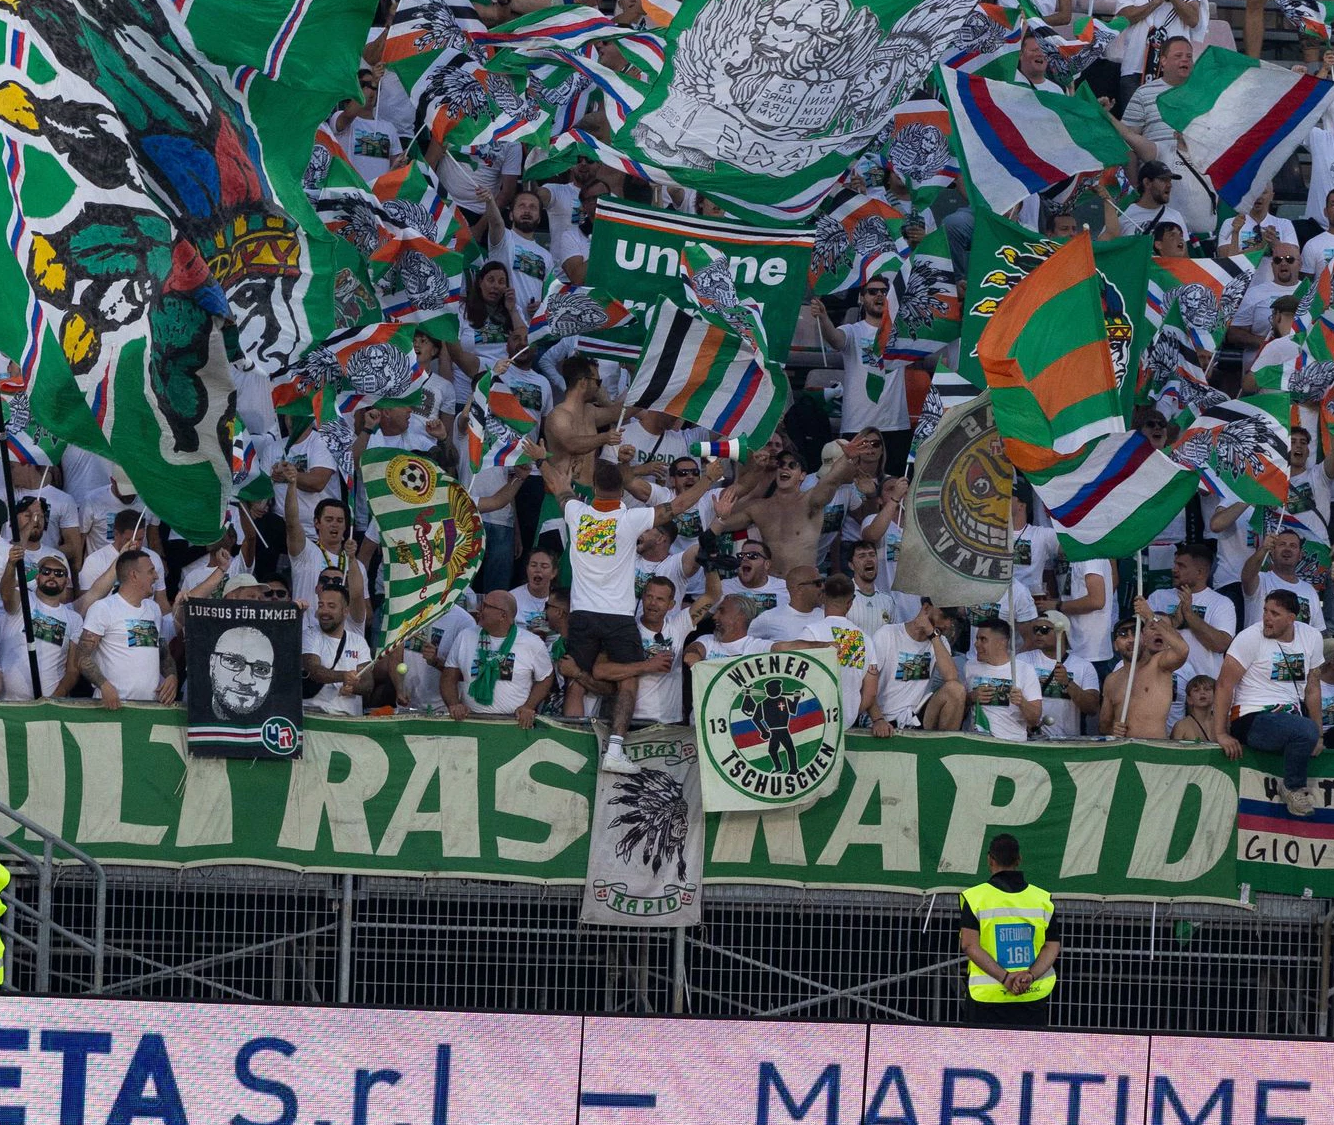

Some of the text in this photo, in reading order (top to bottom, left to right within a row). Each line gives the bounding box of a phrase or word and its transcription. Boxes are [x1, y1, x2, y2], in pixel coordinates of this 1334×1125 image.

[615, 238, 787, 286] unne
[577, 544, 616, 555] WIEN
[189, 605, 298, 620] LUKSUS FÜR IMMER
[727, 655, 810, 688] WIENER
[825, 707, 839, 724] 12
[709, 718, 727, 735] 13
[720, 742, 836, 796] TSCHUSCHEN
[612, 892, 678, 914] RAPID
[1006, 946, 1032, 964] 168
